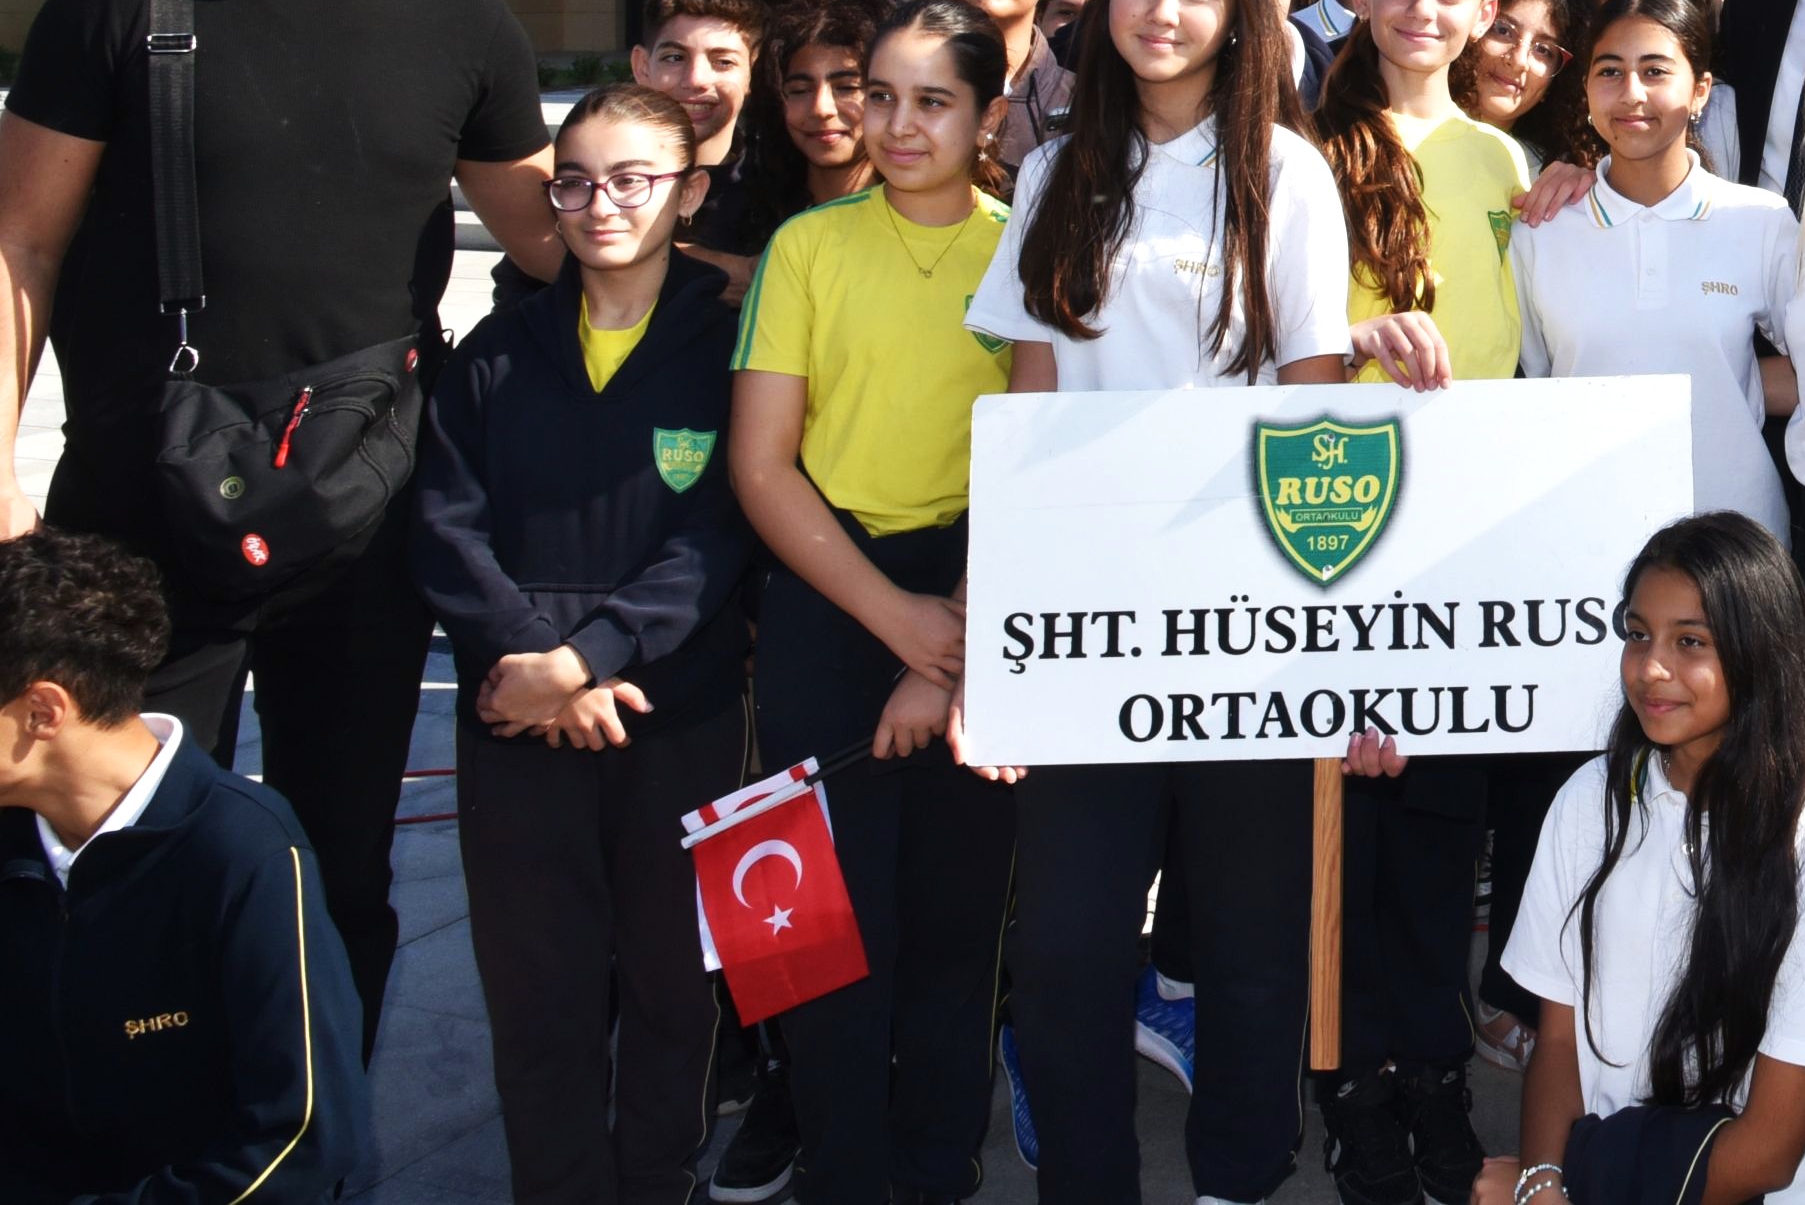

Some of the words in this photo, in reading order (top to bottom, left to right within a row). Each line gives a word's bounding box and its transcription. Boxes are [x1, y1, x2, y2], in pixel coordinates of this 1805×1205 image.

[1701, 281, 1739, 296] ŞHRO
[662, 448, 705, 462] RUSO
[1275, 474, 1381, 505] RUSO
[1306, 535, 1350, 551] 1897
[1003, 611, 1142, 674] ŞHT.
[1161, 590, 1460, 656] HÜSEYİN
[1118, 684, 1539, 743] ORTAOKULU
[124, 1011, 189, 1040] ŞHRO
